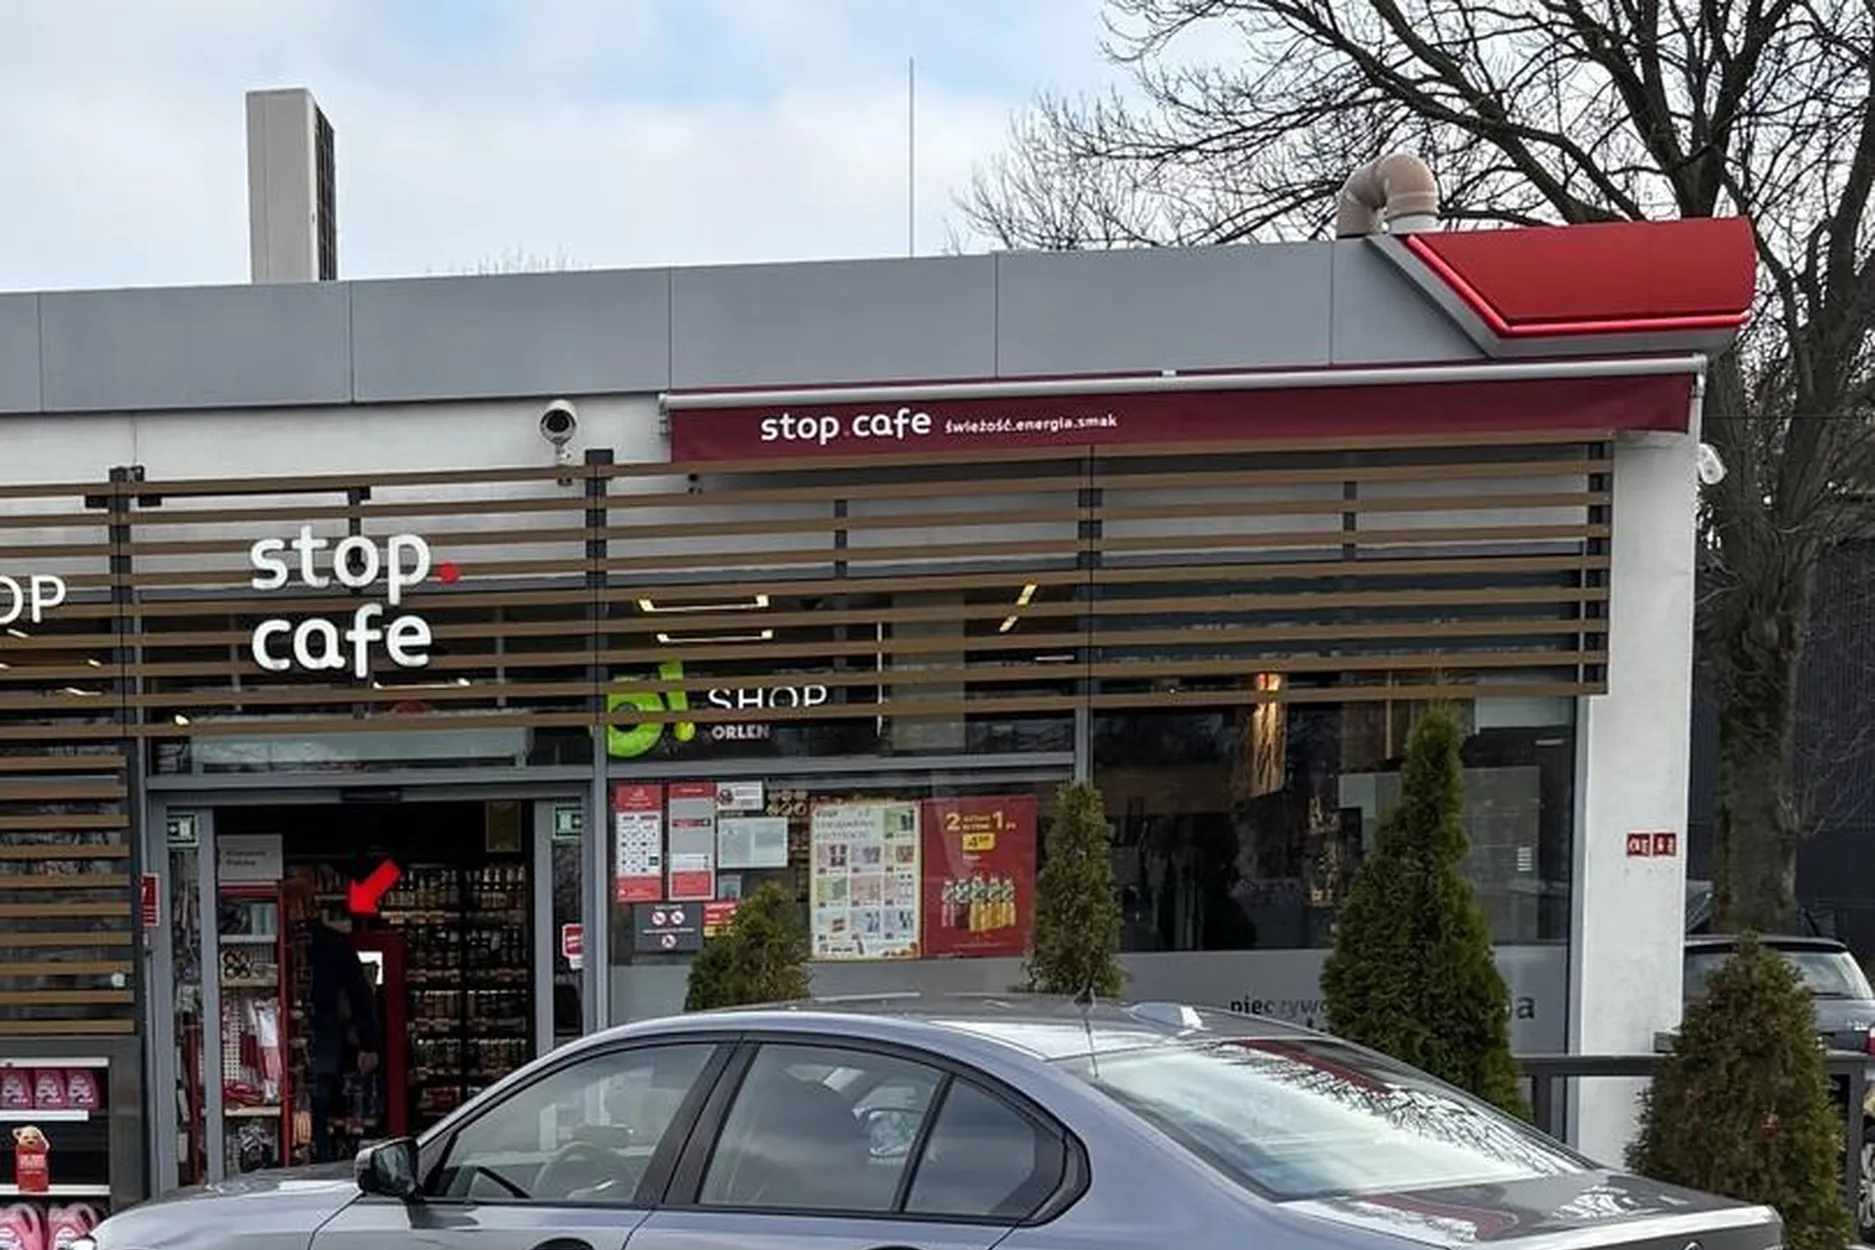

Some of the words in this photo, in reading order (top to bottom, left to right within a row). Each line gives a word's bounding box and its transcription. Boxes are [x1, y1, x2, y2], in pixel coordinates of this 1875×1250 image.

[852, 407, 932, 440] cafe
[251, 602, 433, 679] cafe
[707, 684, 828, 709] SHOP
[711, 724, 771, 740] ORLEN
